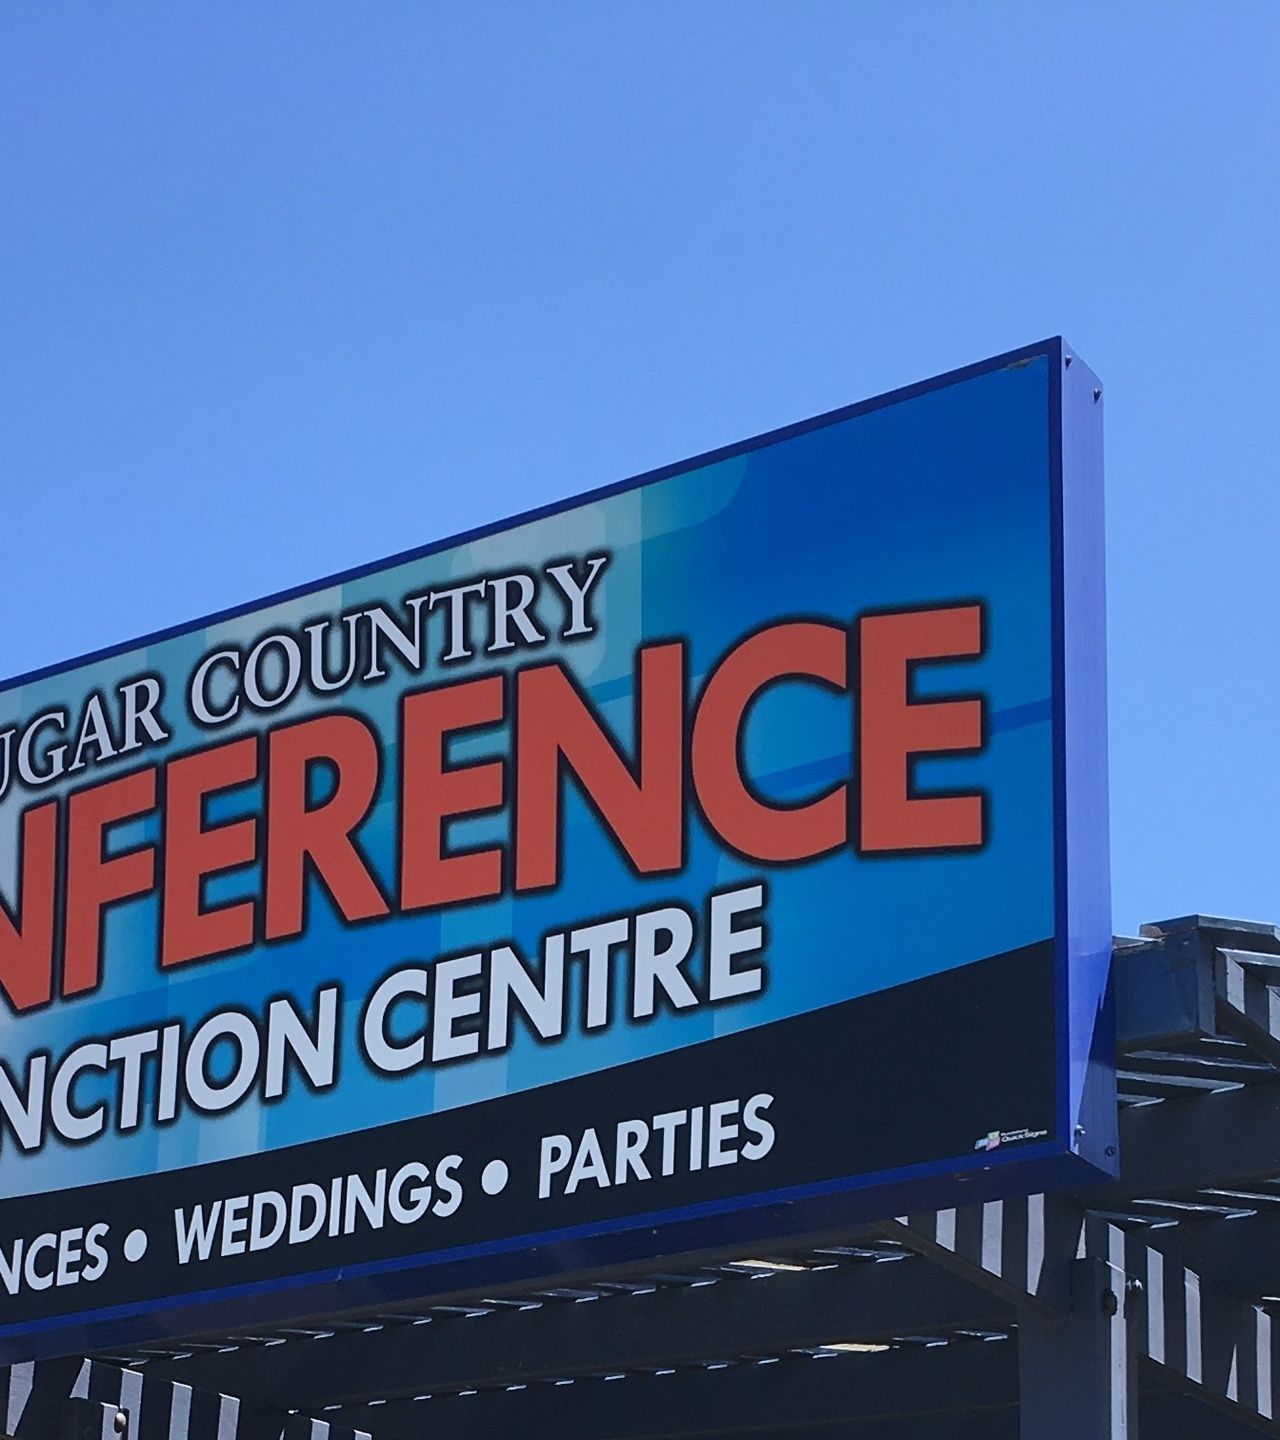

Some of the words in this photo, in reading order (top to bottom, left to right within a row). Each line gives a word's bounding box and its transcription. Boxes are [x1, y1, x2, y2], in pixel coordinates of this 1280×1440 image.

[191, 556, 607, 724] COUNTRY
[363, 884, 765, 1073] CENTRE
[173, 1153, 465, 1265] WEDDINGS
[537, 1093, 776, 1199] PARTIES
